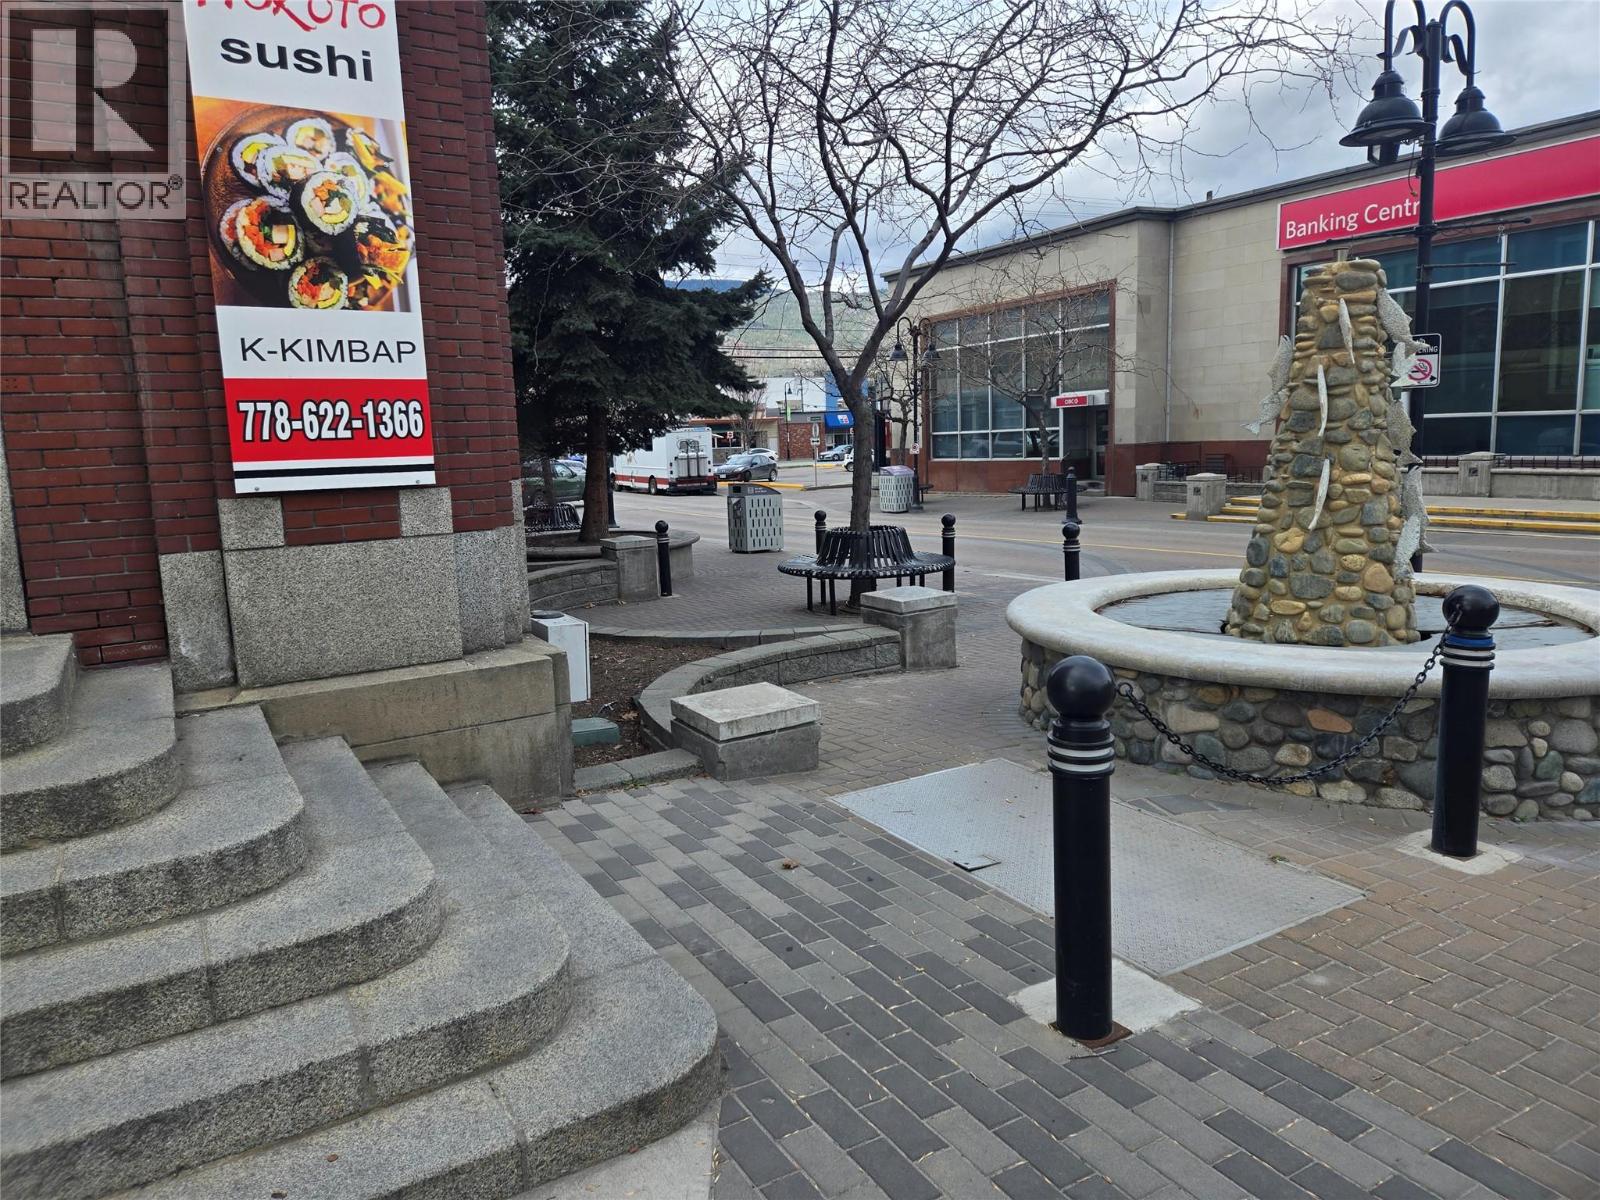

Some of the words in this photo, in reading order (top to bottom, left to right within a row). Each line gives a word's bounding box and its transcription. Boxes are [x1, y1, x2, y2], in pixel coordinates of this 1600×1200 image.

[220, 38, 373, 82] sushi
[1285, 212, 1359, 239] Banking
[1364, 198, 1420, 224] Centr
[240, 337, 416, 363] K-KIMBAP
[237, 399, 424, 442] 778-622-1366
